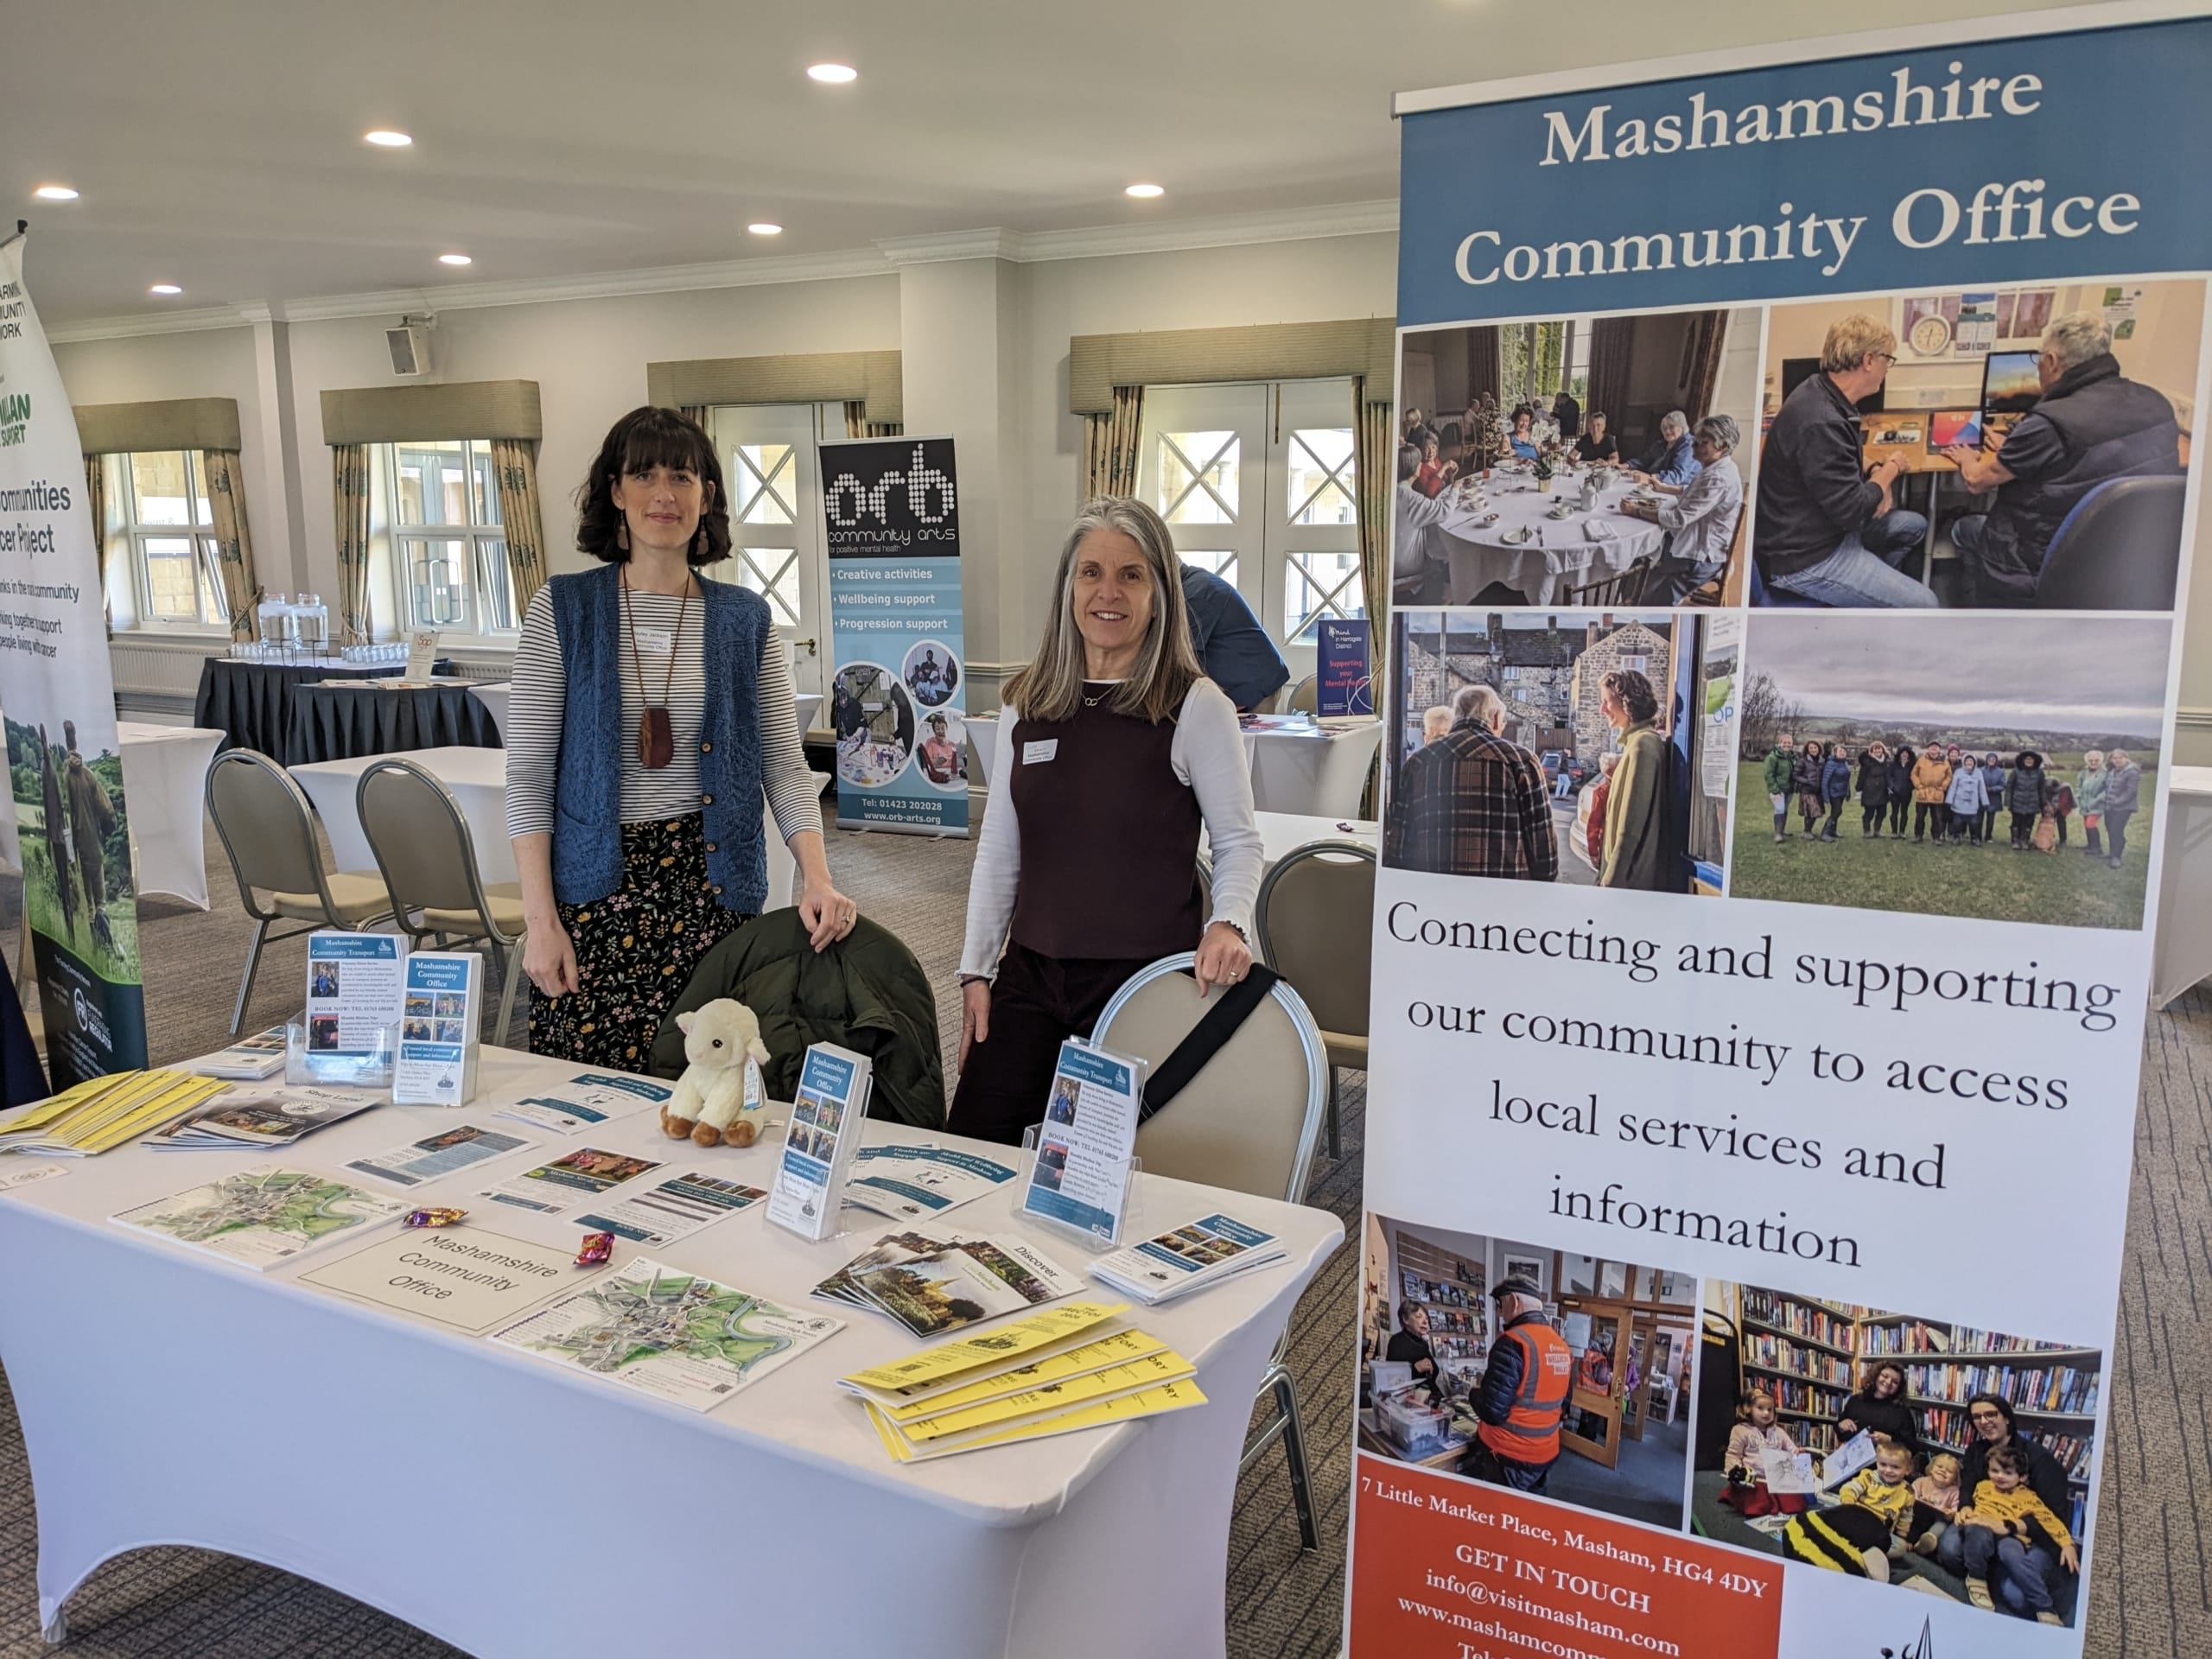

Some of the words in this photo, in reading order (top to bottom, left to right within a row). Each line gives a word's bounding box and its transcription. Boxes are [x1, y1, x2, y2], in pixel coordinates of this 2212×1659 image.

[1539, 61, 2043, 166] Mashamshire
[1455, 202, 1867, 285] Community
[1892, 179, 2140, 249] Office
[825, 443, 955, 526] orb
[828, 528, 910, 546] community
[918, 528, 955, 540] arts
[836, 544, 858, 555] positive
[860, 544, 881, 554] mental
[882, 543, 901, 553] health
[837, 569, 882, 580] Creative
[884, 569, 933, 580] activities
[838, 594, 891, 607] Wellbeing
[893, 594, 936, 607] support
[840, 618, 903, 631] Progression
[906, 619, 948, 631] support
[1329, 659, 1363, 668] Supporting
[861, 798, 878, 807] Tel:
[880, 799, 906, 809] 01423
[909, 801, 943, 811] 202028
[864, 811, 941, 825] www.orb-arts.org
[312, 949, 346, 957] Community
[348, 949, 376, 957] Transport
[416, 962, 461, 971] Mashamshire
[417, 970, 458, 981] Community
[1386, 901, 1661, 982] Connecting
[1677, 935, 1774, 980] and
[1796, 960, 2121, 1032] supporting
[812, 1055, 848, 1075] Mashamshire
[1073, 1052, 1104, 1070] Mashamshire
[1408, 1001, 1486, 1034] our
[1502, 1025, 1791, 1086] community
[1812, 1045, 1865, 1083] to
[1886, 1060, 2069, 1109] access
[811, 1066, 843, 1086] Community
[1059, 1060, 1090, 1078] Community
[1090, 1066, 1113, 1086] Transport
[304, 1090, 333, 1098] Shop
[817, 1078, 833, 1093] Office
[1048, 1132, 1065, 1141] BOOK
[1489, 1080, 1599, 1136] local
[1618, 1114, 1822, 1169] services
[1844, 1144, 1947, 1190] and
[1549, 1174, 1861, 1268] information
[423, 1235, 558, 1278] Mashamshire
[1014, 1245, 1059, 1280] Discover
[398, 1252, 520, 1292] Community
[389, 1275, 453, 1300] Office
[1361, 1476, 1371, 1492] 7
[1376, 1481, 1424, 1508] Little
[1428, 1494, 1496, 1526] Market
[1500, 1513, 1558, 1548] Place,
[1563, 1529, 1656, 1573] Masham,
[1662, 1556, 1713, 1586] HG4
[1719, 1573, 1768, 1599] 4DY
[1455, 1543, 1509, 1573] GET
[1515, 1560, 1545, 1585] IN
[1551, 1569, 1651, 1615] TOUCH
[1426, 1568, 1681, 1658] info@visitmasham.com
[1397, 1597, 1606, 1659] www.mashamcom
